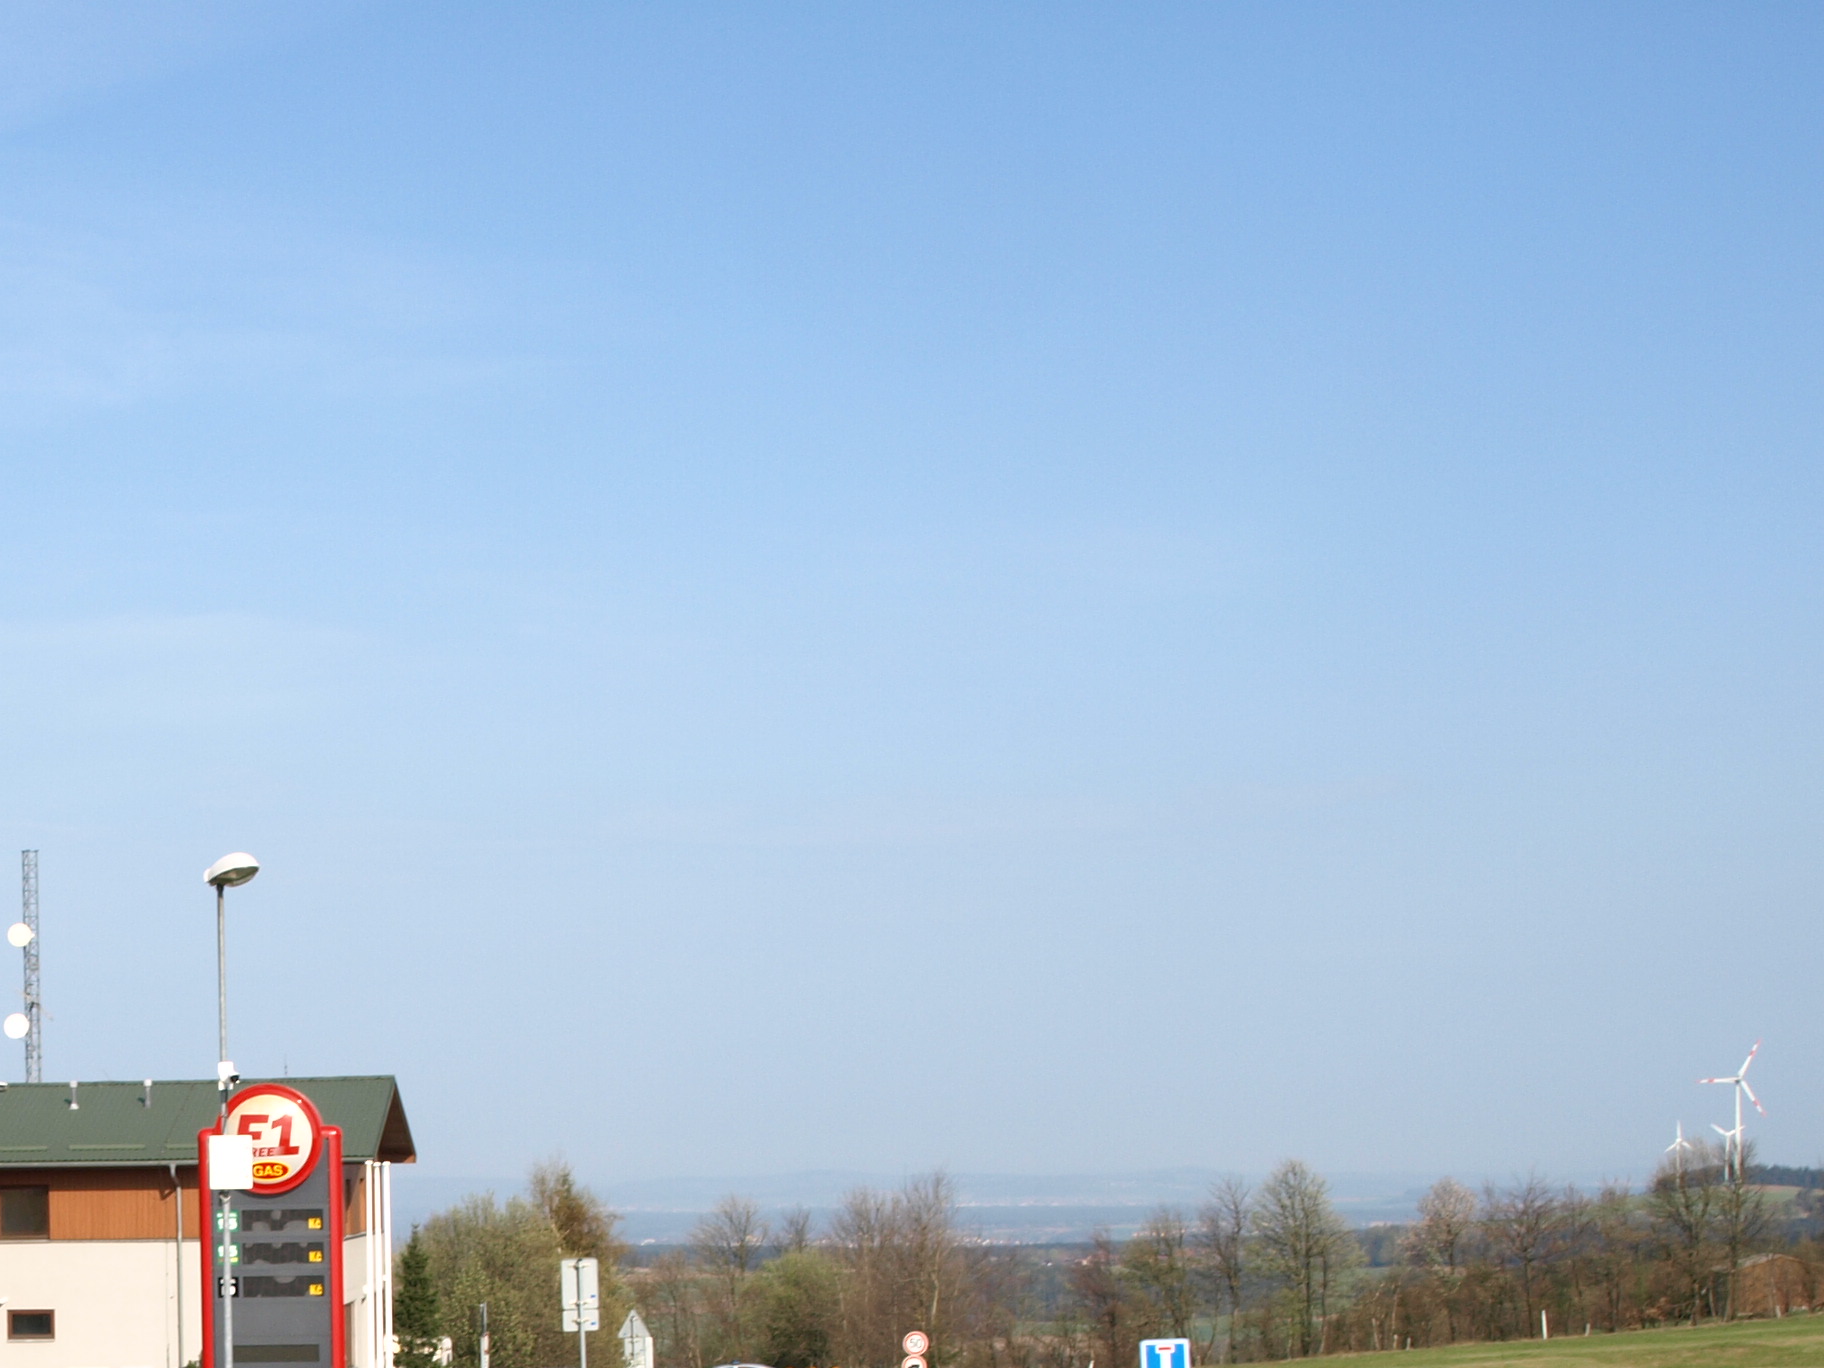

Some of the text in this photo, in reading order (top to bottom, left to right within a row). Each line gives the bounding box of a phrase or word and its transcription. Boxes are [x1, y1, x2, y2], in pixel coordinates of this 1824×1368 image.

[237, 1114, 300, 1156] F1
[253, 1147, 275, 1157] REE
[253, 1164, 283, 1177] GAS
[910, 1338, 922, 1349] 50
